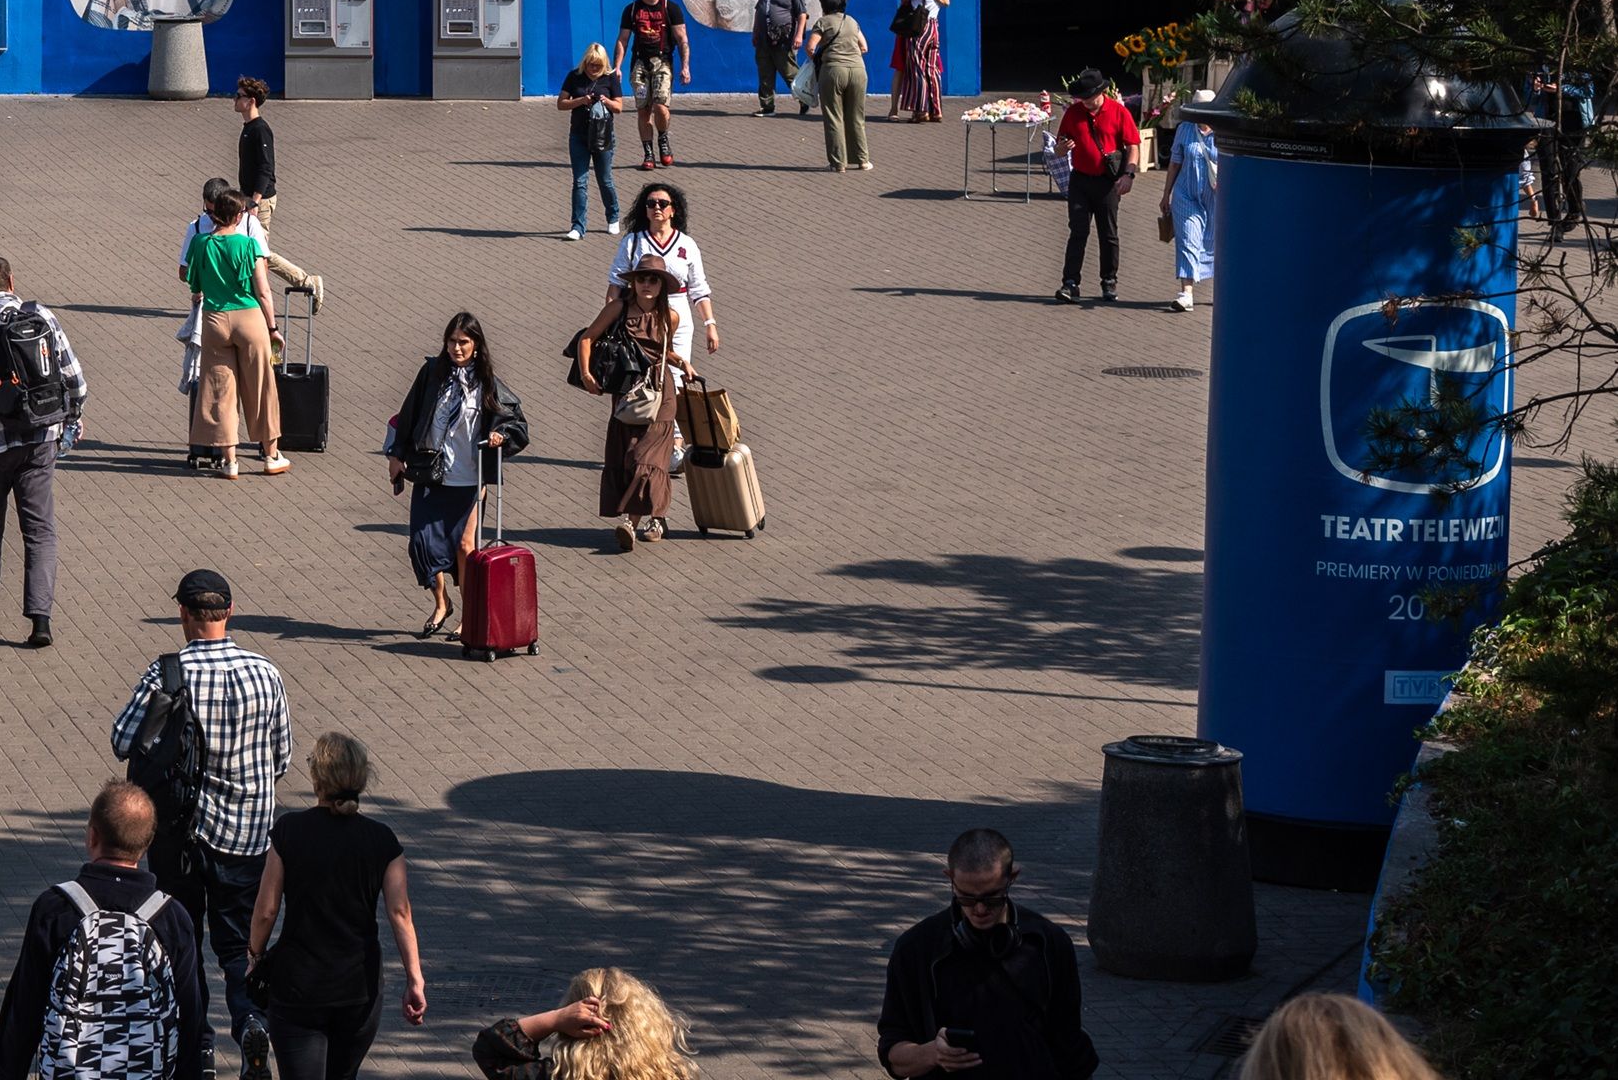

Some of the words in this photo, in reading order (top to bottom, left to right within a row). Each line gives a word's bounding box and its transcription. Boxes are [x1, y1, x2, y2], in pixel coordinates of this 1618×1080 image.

[1320, 514, 1404, 542] TEATR
[1408, 515, 1504, 542] TELEWIZJI
[1315, 560, 1402, 581] PREMIERY
[1406, 565, 1424, 581] W
